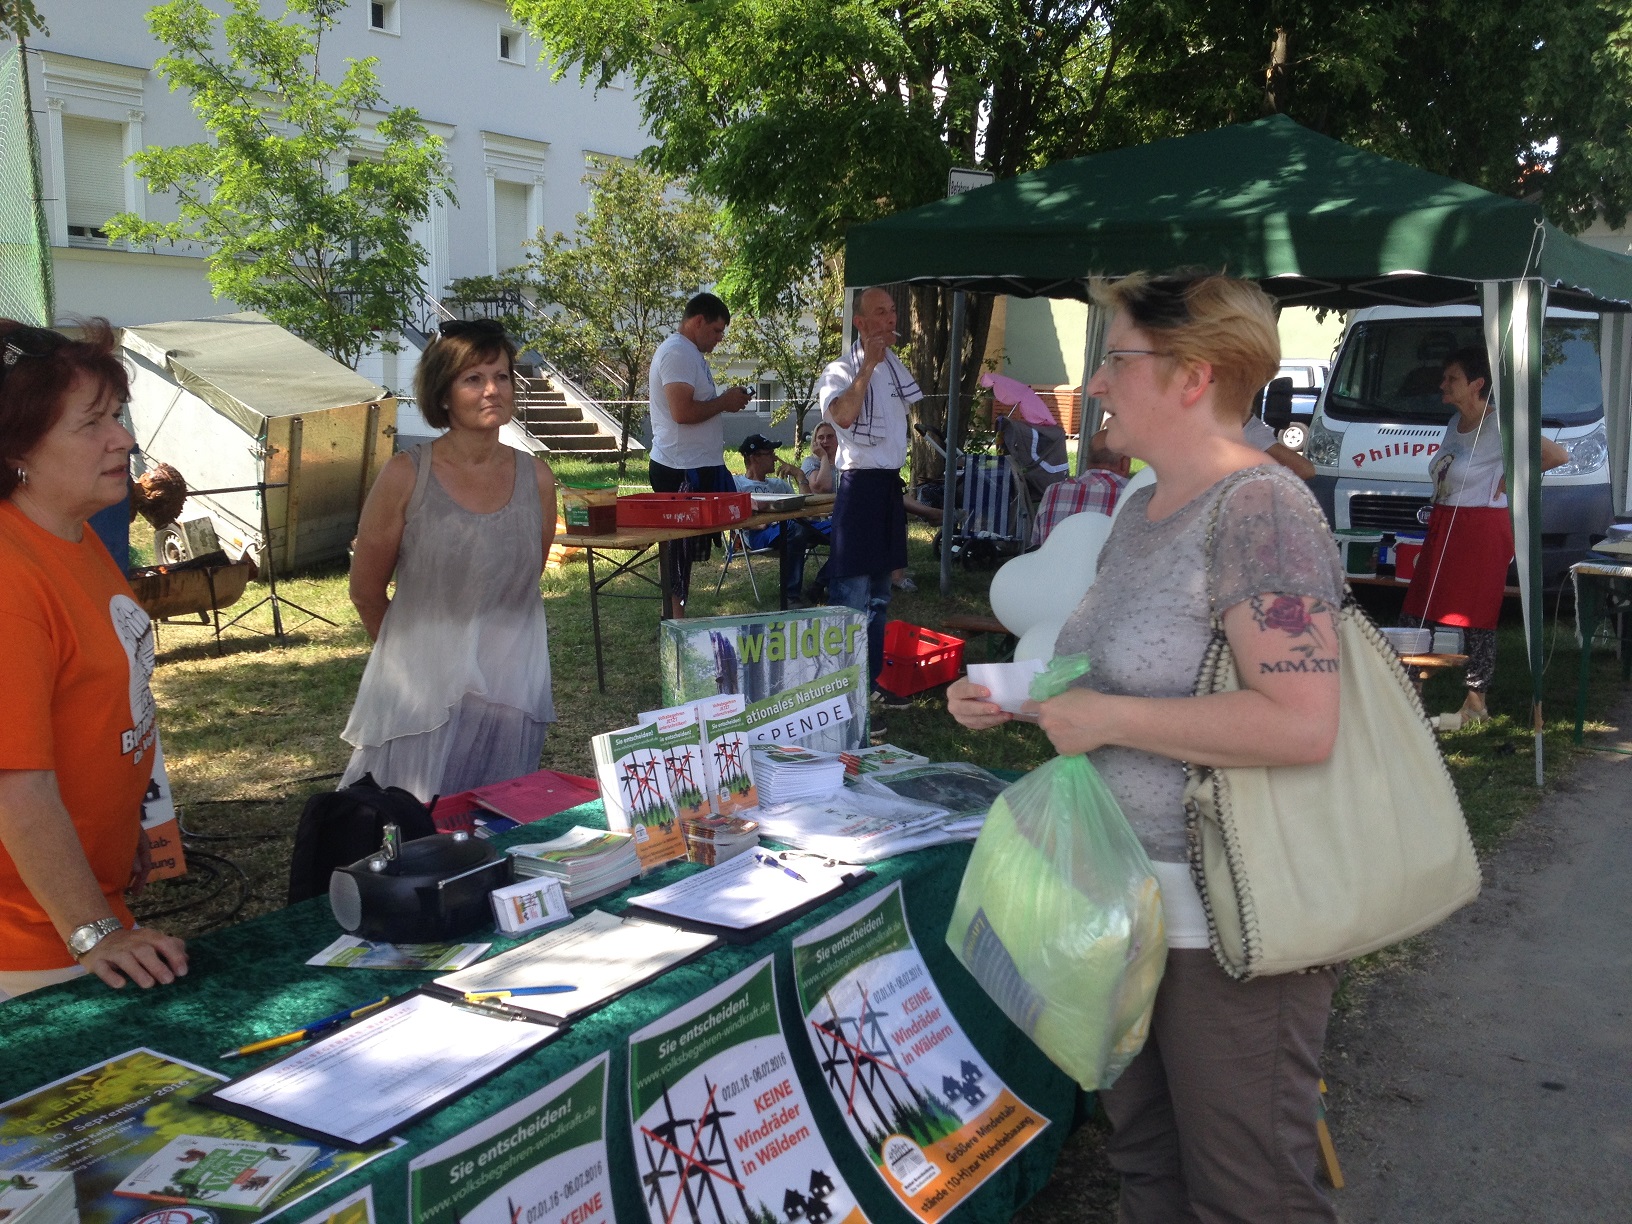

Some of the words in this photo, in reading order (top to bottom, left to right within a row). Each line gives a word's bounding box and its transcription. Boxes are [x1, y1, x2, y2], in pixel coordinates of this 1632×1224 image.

[737, 618, 862, 665] wälder
[745, 698, 795, 725] ationales
[796, 677, 849, 704] Naturerbe
[816, 948, 830, 964] Sie
[832, 912, 884, 951] entscheiden!
[902, 987, 932, 1015] KEINE
[636, 1001, 771, 1089] www.volksbegehren-windkraft.de
[658, 1040, 676, 1059] Sie
[679, 992, 749, 1046] entscheiden!
[891, 1007, 942, 1047] Windräder
[902, 1052, 914, 1065] in
[911, 1025, 953, 1058] Wäldern
[73, 1096, 151, 1132] September
[154, 1079, 190, 1098] 2016
[753, 1079, 793, 1114] KEINE
[450, 1160, 474, 1184] Sie
[477, 1097, 572, 1167] entscheiden!
[734, 1103, 800, 1152] Windräder
[741, 1158, 757, 1176] in
[755, 1125, 810, 1167] Wäldern
[946, 1137, 978, 1163] Größere
[921, 1188, 949, 1212] stände
